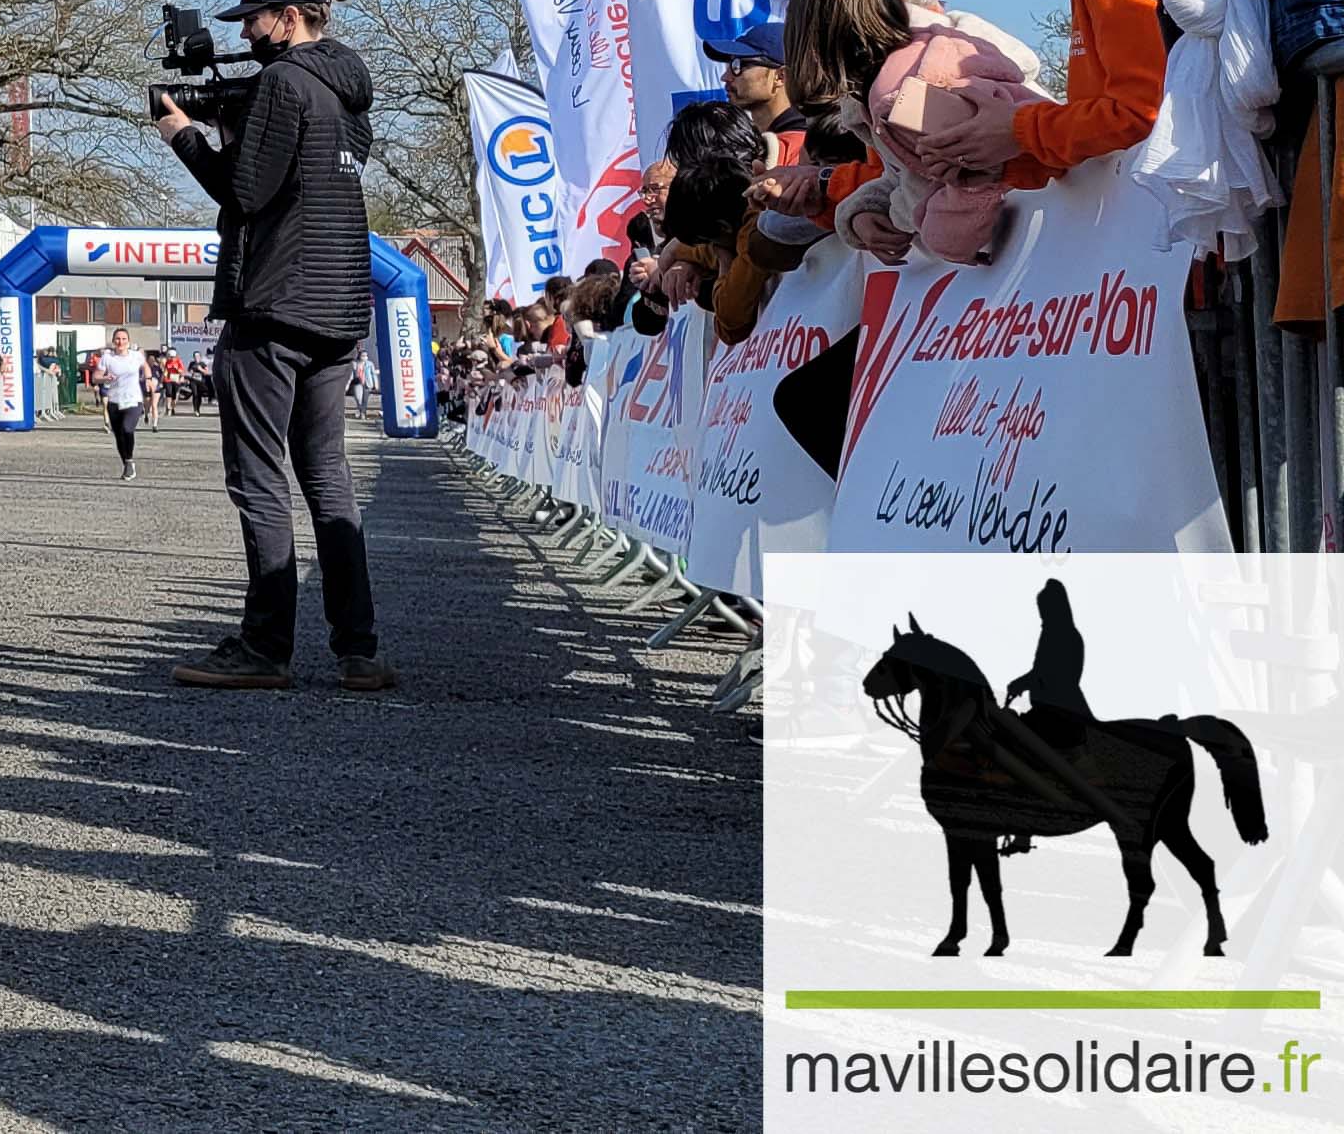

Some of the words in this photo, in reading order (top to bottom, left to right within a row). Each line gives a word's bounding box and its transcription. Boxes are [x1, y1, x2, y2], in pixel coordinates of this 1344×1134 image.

[0, 307, 13, 400] INTERSPORT
[395, 309, 417, 403] INTERSPORT
[914, 316, 949, 362] La
[949, 269, 1159, 362] Roche-sur-Yon
[932, 376, 977, 442] Ville
[972, 390, 996, 437] et
[985, 377, 1046, 489] Agglo
[876, 459, 906, 522] Le
[967, 457, 1072, 556] Vendée
